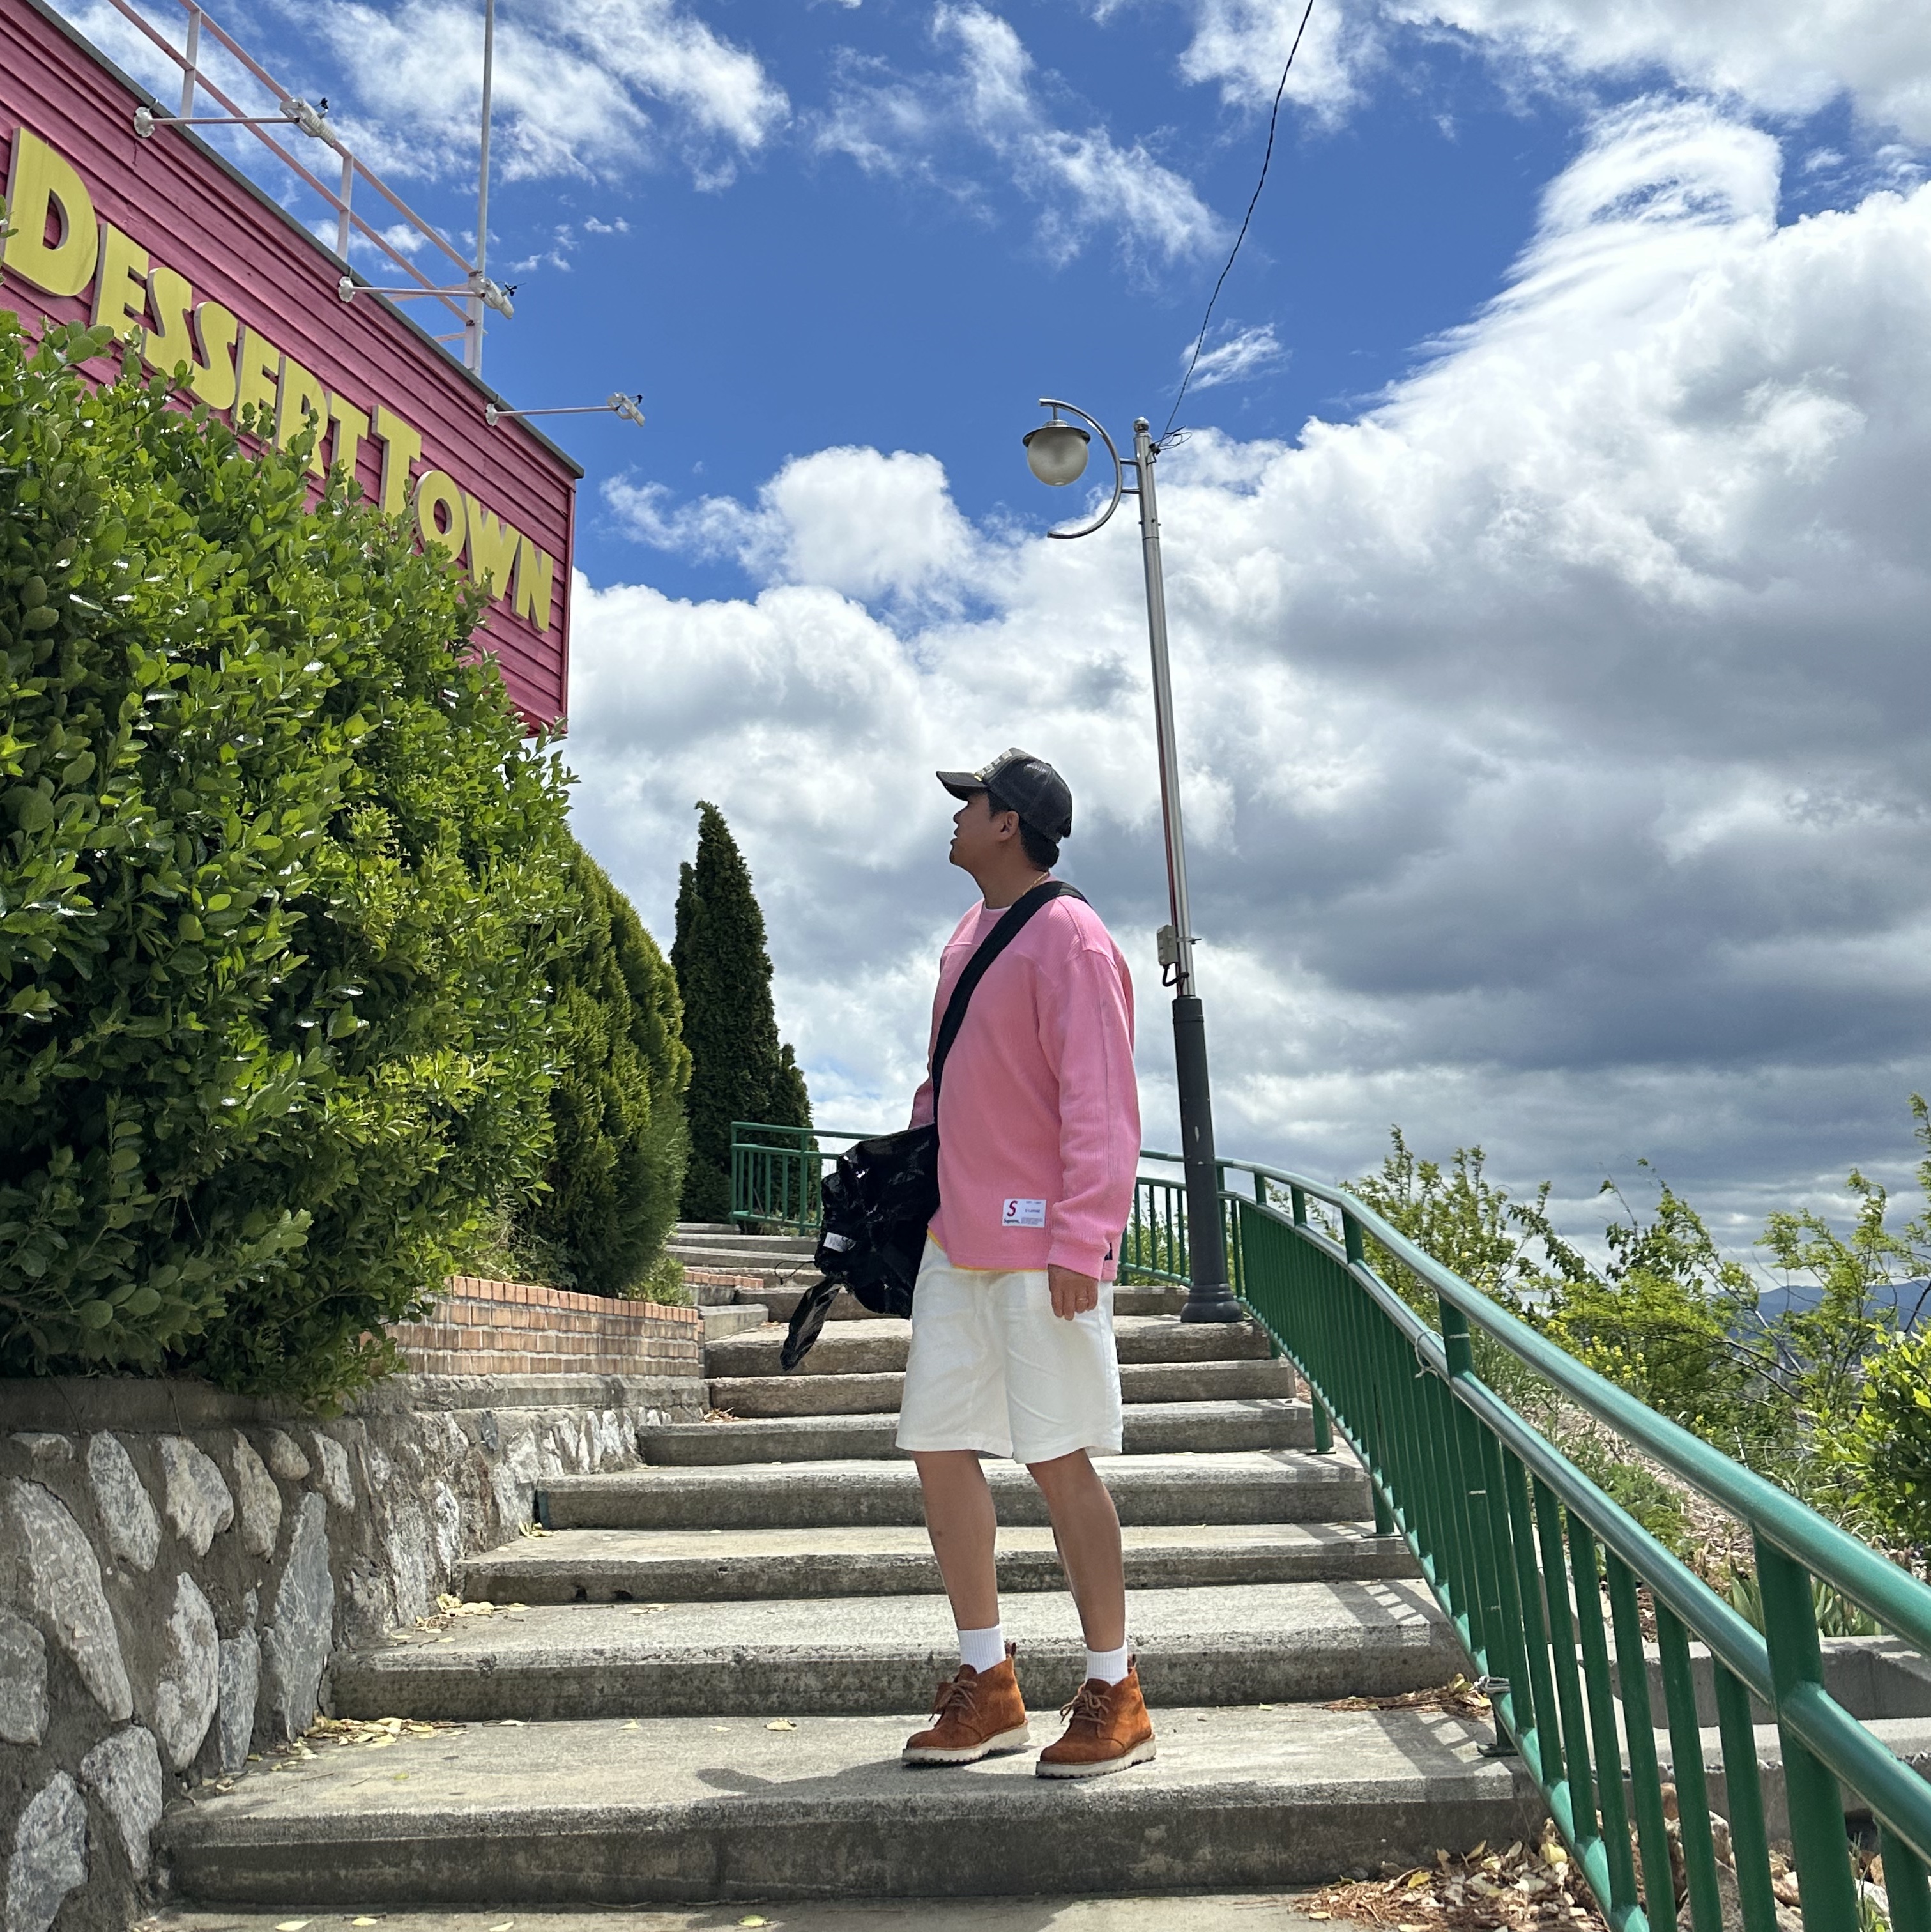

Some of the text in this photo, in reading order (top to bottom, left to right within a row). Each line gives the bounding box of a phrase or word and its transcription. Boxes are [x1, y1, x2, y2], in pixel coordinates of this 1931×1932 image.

[2, 126, 553, 633] DESSERT TOWN
[1007, 1200, 1018, 1216] S
